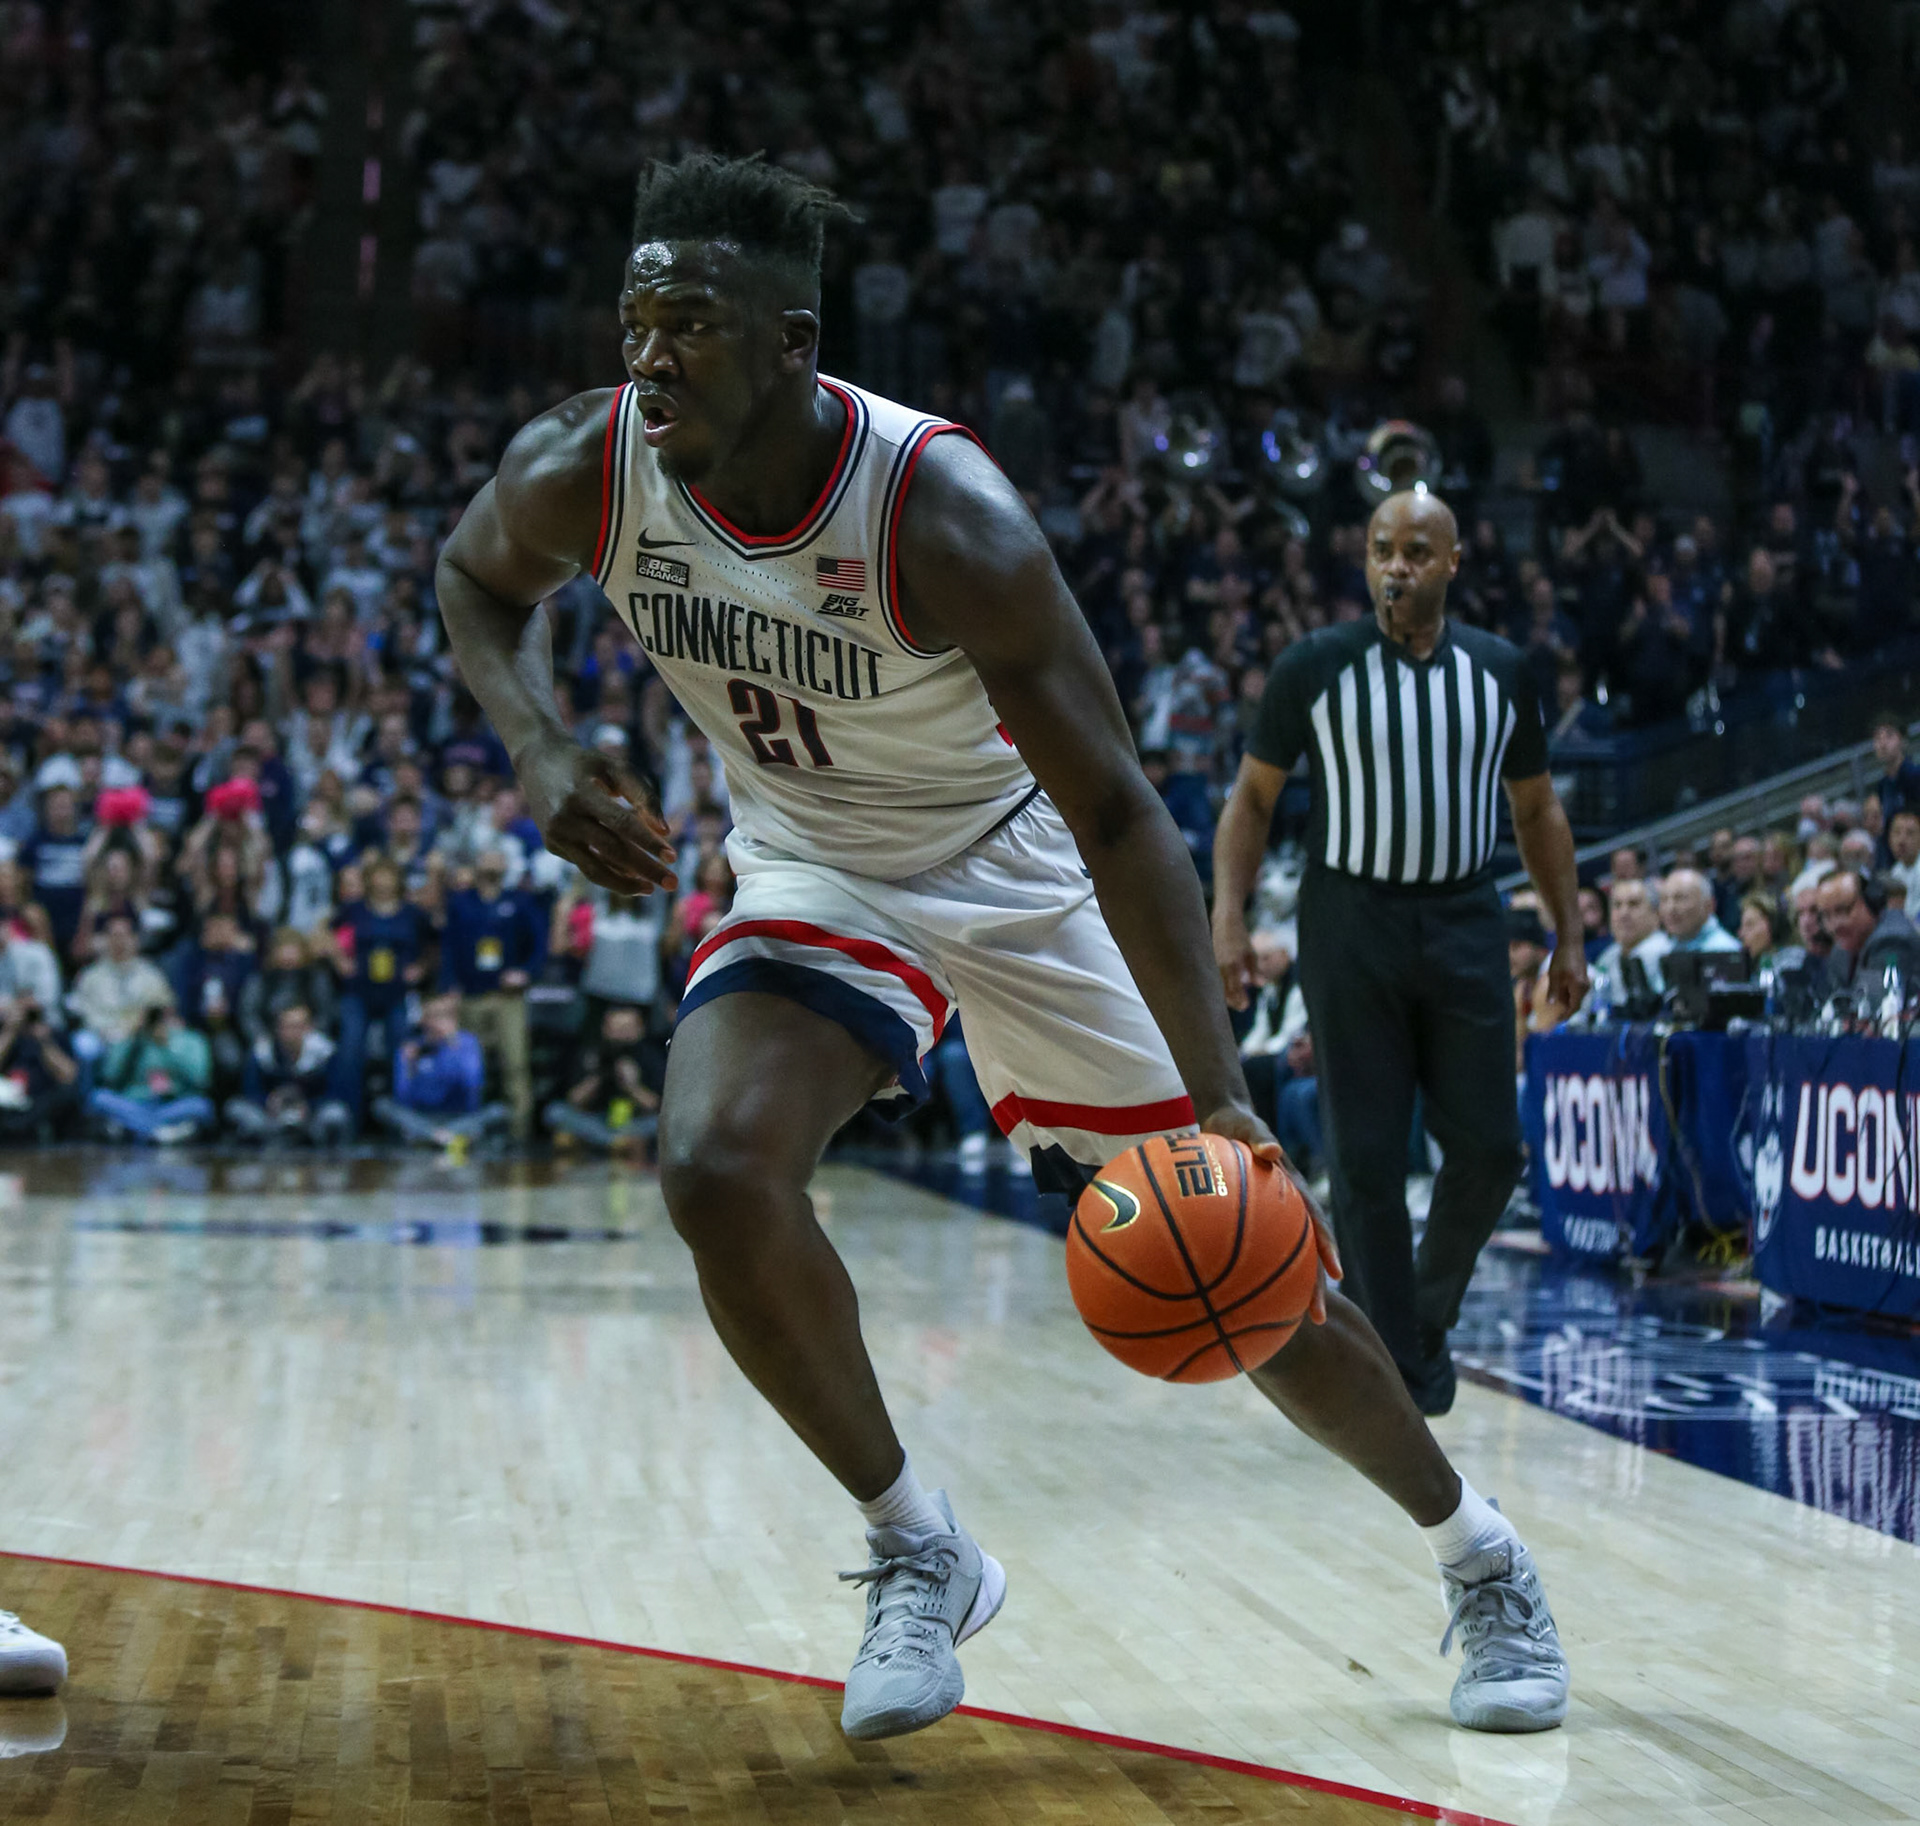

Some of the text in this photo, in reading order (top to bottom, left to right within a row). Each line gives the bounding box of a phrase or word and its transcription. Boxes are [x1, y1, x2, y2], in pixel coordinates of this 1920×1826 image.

[638, 566, 687, 586] CHANGE
[824, 593, 860, 607] BIG
[820, 601, 870, 617] EAST
[628, 593, 883, 700] CONNECTICUT
[727, 678, 834, 768] 21
[1790, 1081, 1920, 1215] UCON
